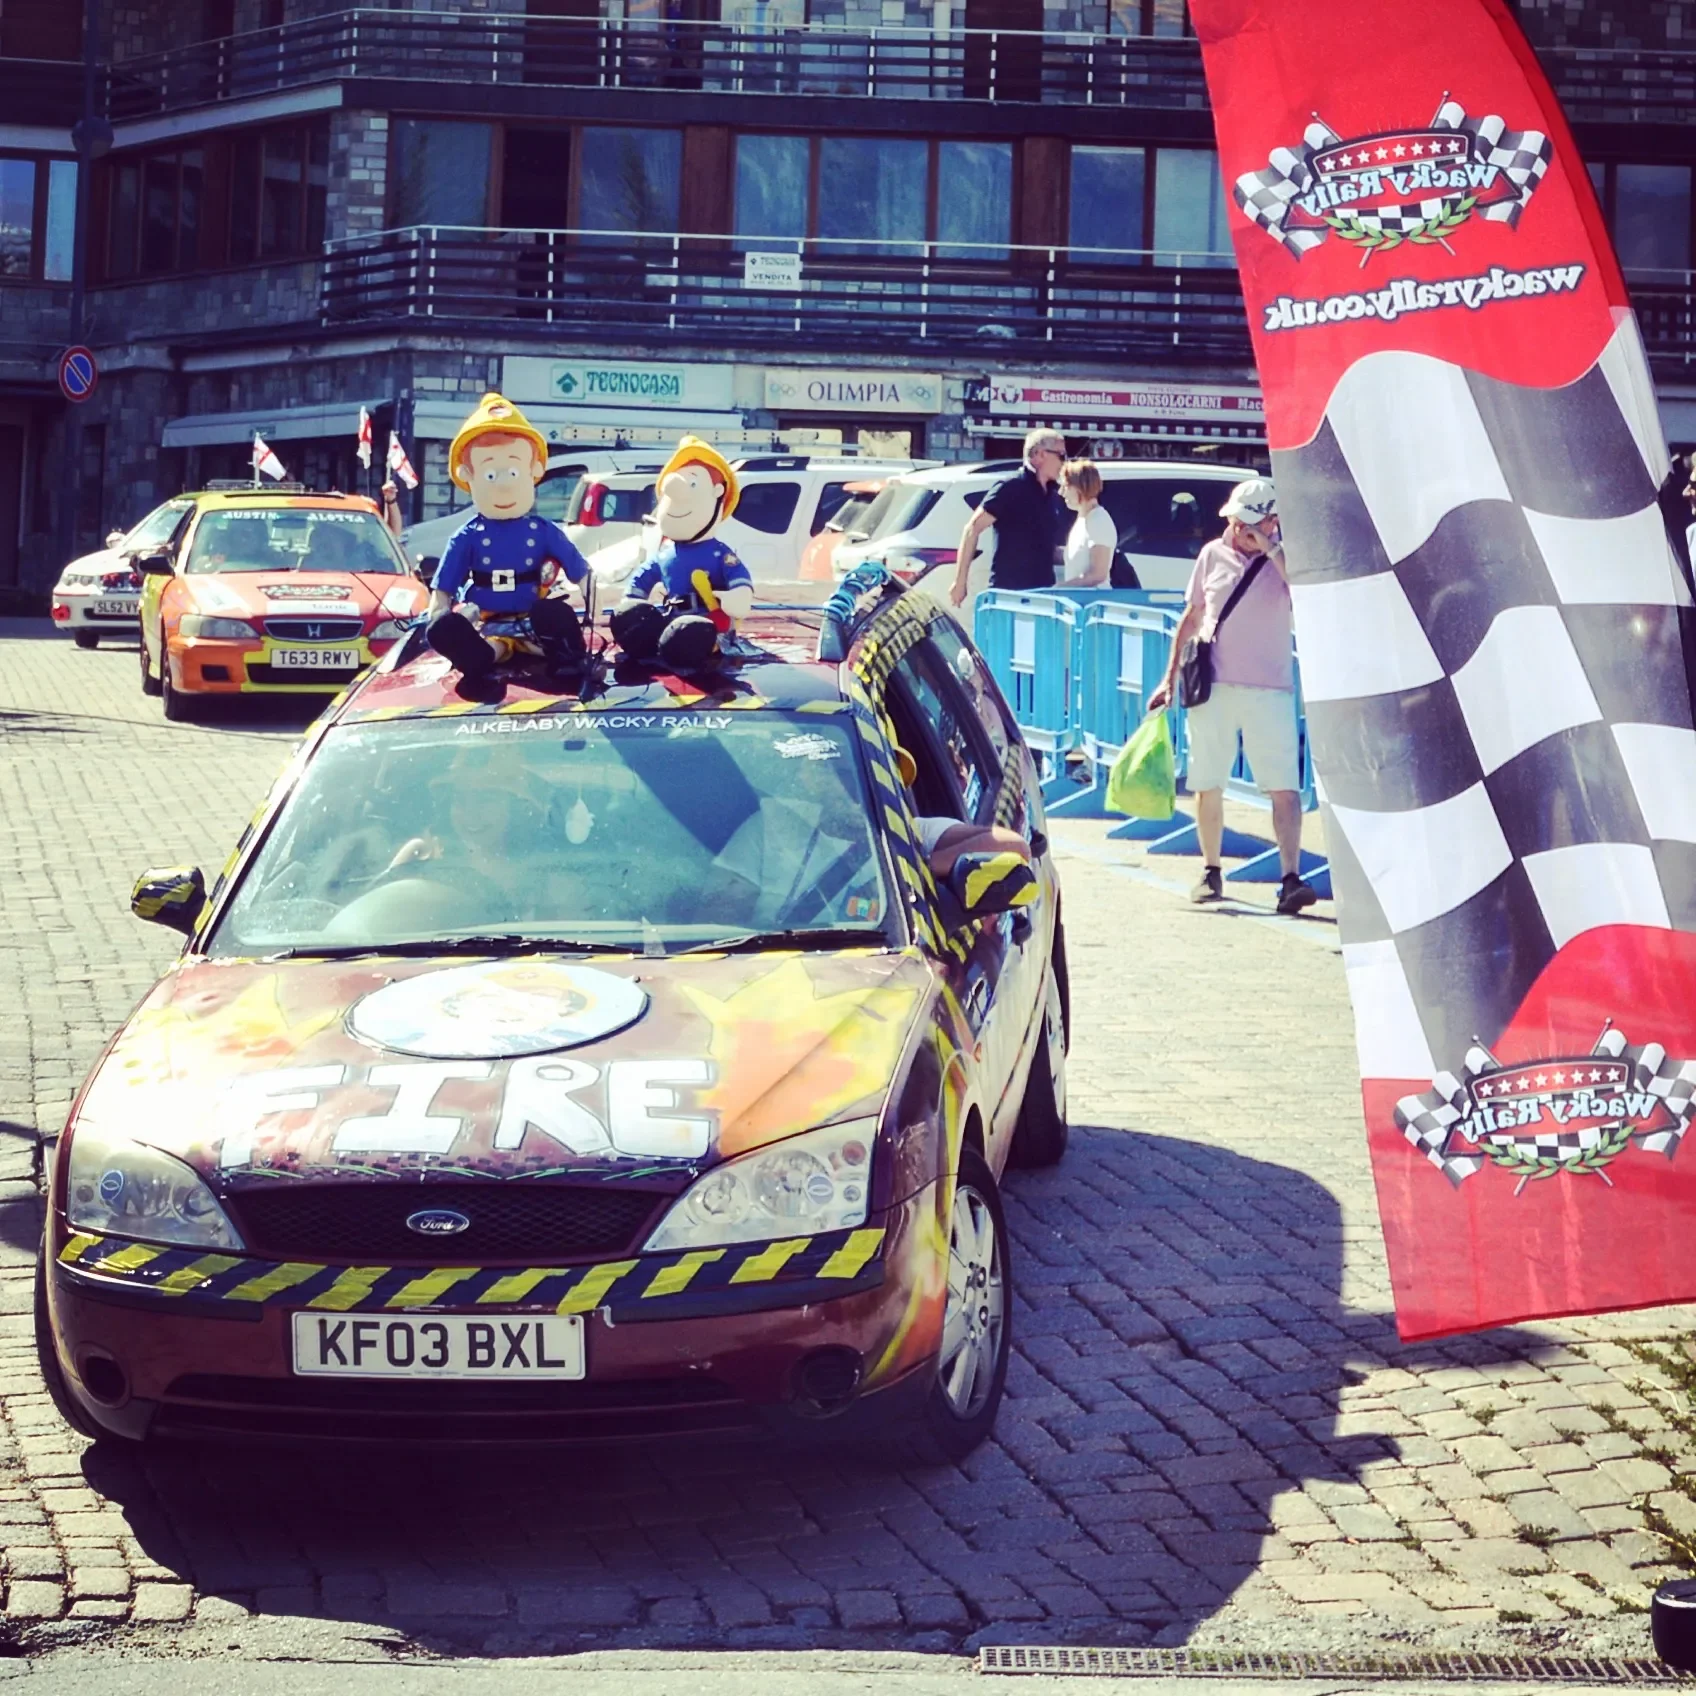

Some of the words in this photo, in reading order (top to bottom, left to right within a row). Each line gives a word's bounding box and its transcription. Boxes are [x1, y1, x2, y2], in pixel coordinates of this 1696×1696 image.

[586, 371, 680, 396] TECNOCASA
[807, 380, 900, 403] OLIMPIA
[1041, 389, 1113, 405] Gastronomia
[1130, 392, 1222, 410] NONSOLOCARNI
[280, 651, 318, 665] T633
[322, 651, 351, 666] RWY
[455, 718, 569, 735] ALKELABY
[573, 716, 656, 729] WACKY
[661, 716, 733, 729] RALLY
[219, 1057, 713, 1168] FIRE
[420, 1215, 456, 1231] Ford
[318, 1320, 449, 1369] KF03
[466, 1322, 566, 1369] BXL
